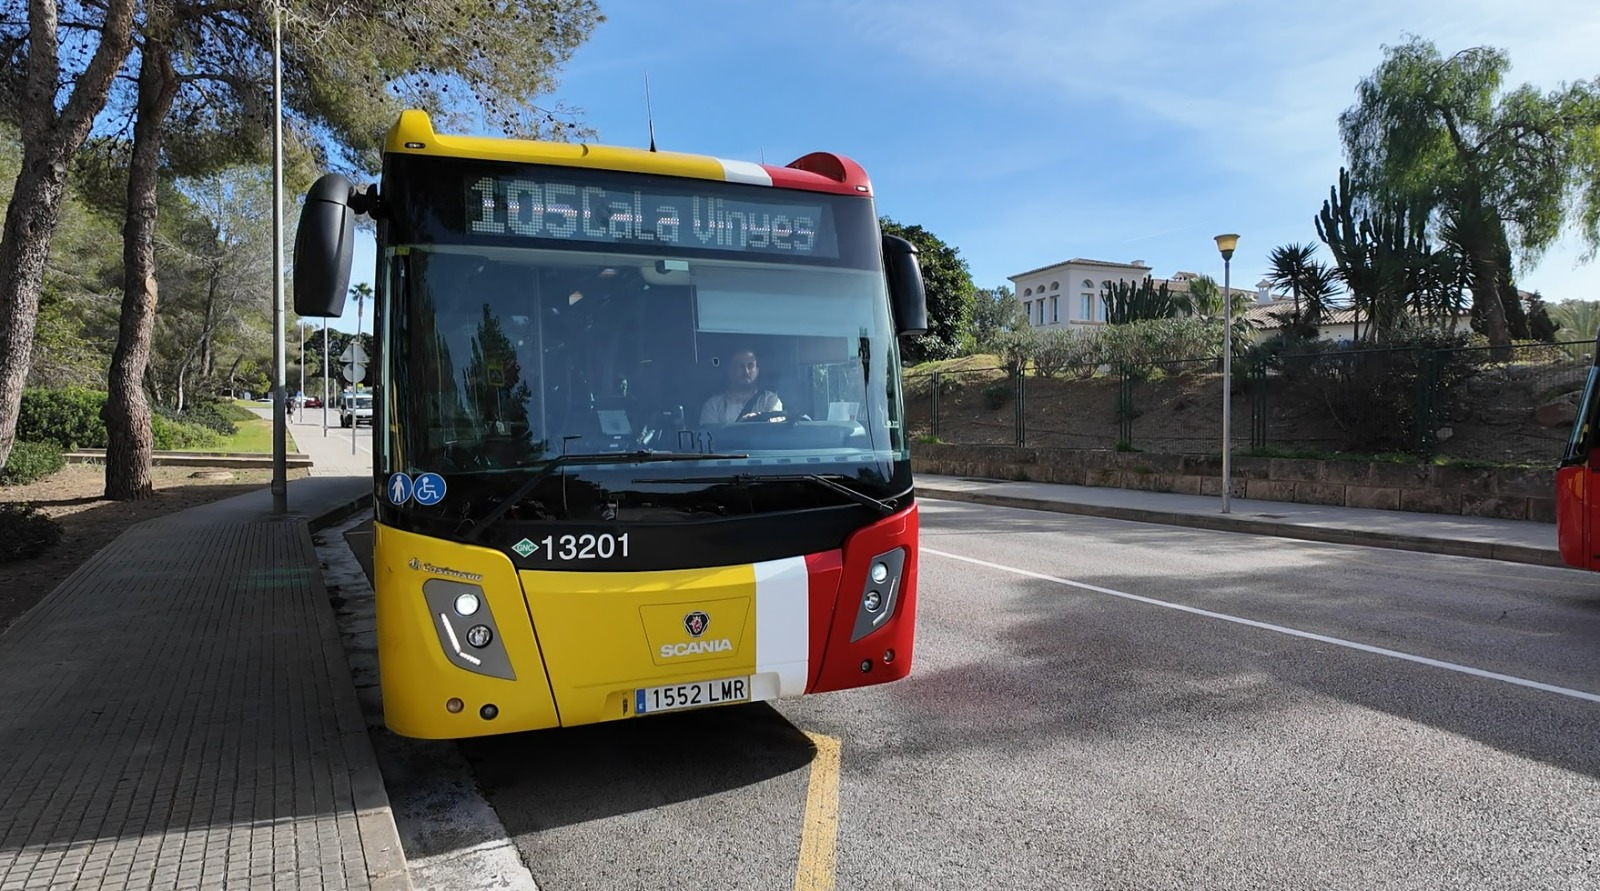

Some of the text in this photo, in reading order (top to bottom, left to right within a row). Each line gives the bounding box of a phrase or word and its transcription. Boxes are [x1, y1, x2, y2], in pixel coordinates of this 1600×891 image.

[471, 177, 578, 238] 105
[693, 195, 815, 250] Vinyes
[541, 533, 629, 561] 13201
[660, 638, 733, 658] SCANIA
[653, 685, 702, 709] 1552
[708, 680, 745, 702] LMR
